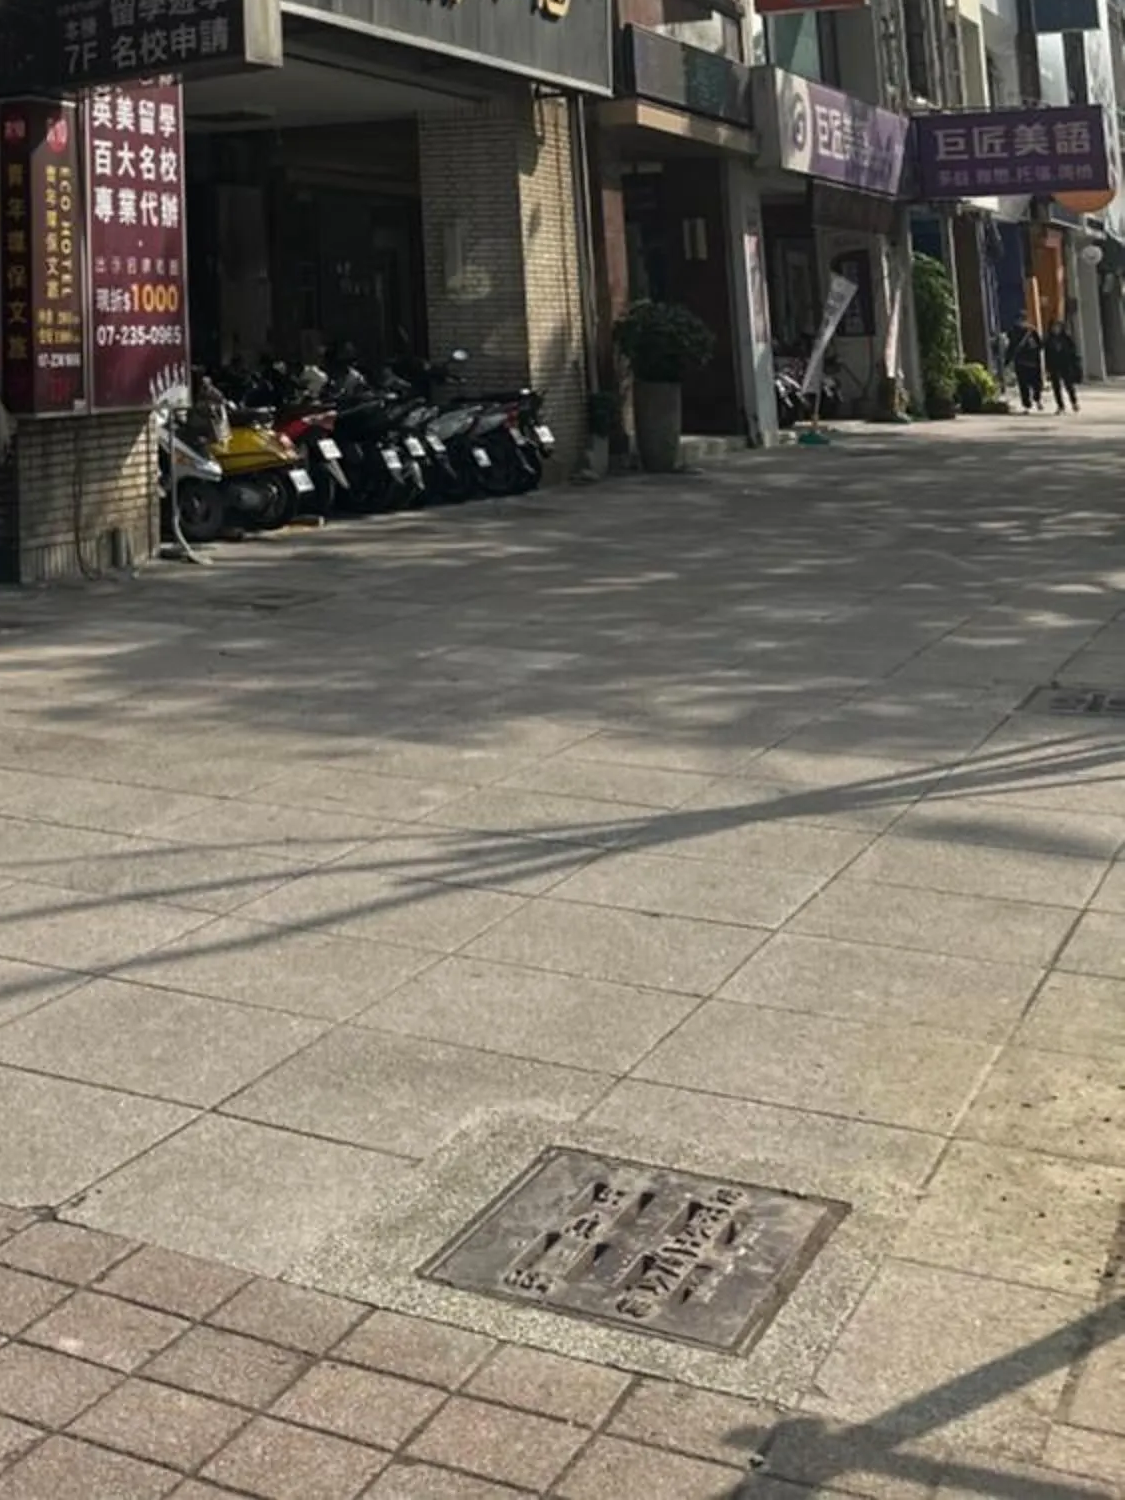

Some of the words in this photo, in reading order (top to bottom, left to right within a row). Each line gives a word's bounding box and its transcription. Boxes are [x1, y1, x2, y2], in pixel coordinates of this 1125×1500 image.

[63, 40, 100, 75] 7F
[110, 19, 230, 71] 名校申請
[93, 139, 178, 184] 百大名校
[934, 120, 1092, 163] 巨匠美語
